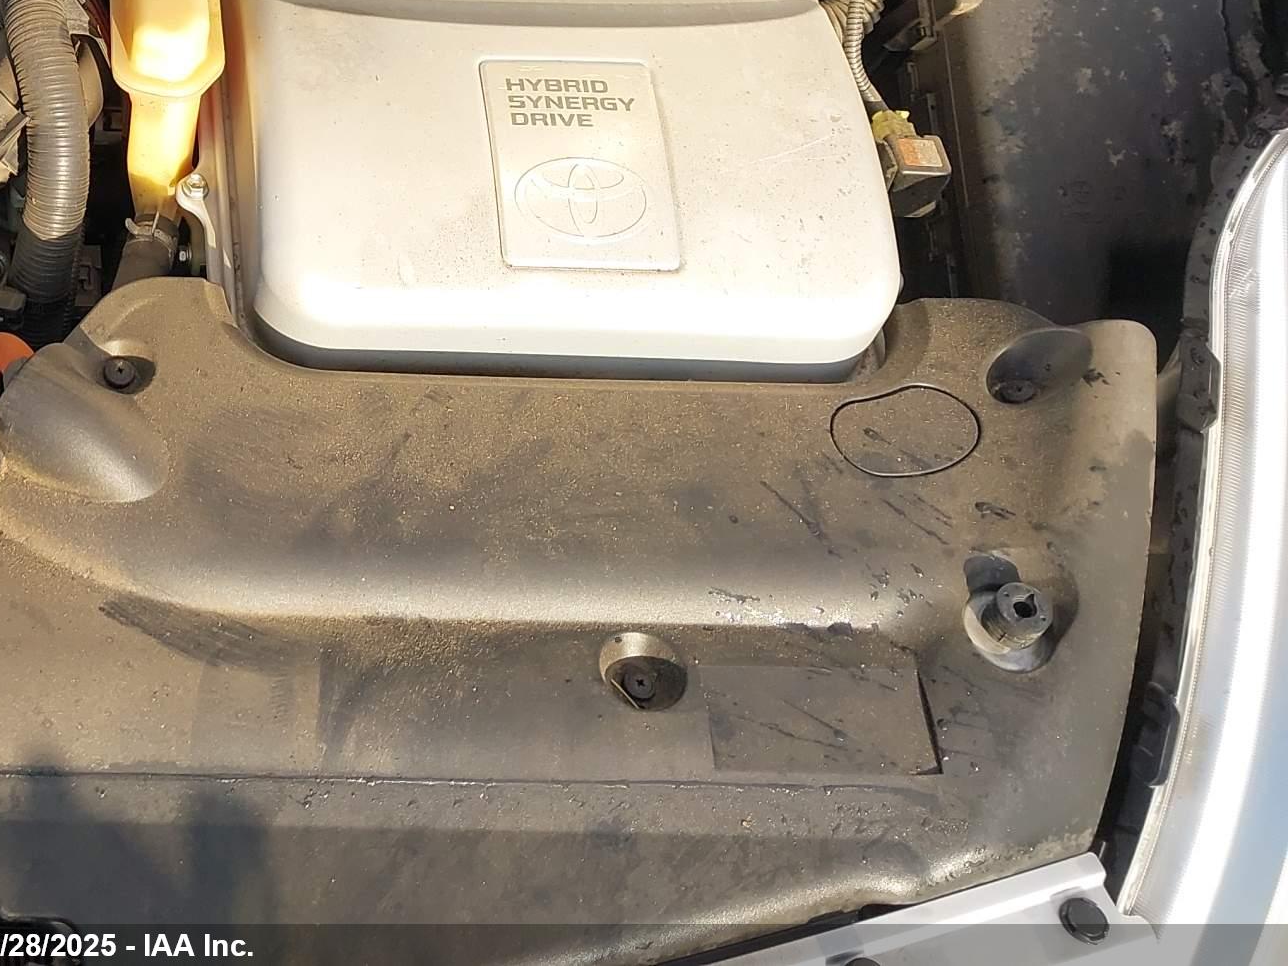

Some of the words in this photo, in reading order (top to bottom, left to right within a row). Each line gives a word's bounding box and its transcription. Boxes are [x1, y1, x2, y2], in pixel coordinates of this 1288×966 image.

[505, 78, 609, 94] HYBRID
[508, 95, 635, 112] SYNERGY
[510, 112, 594, 127] DRIVE
